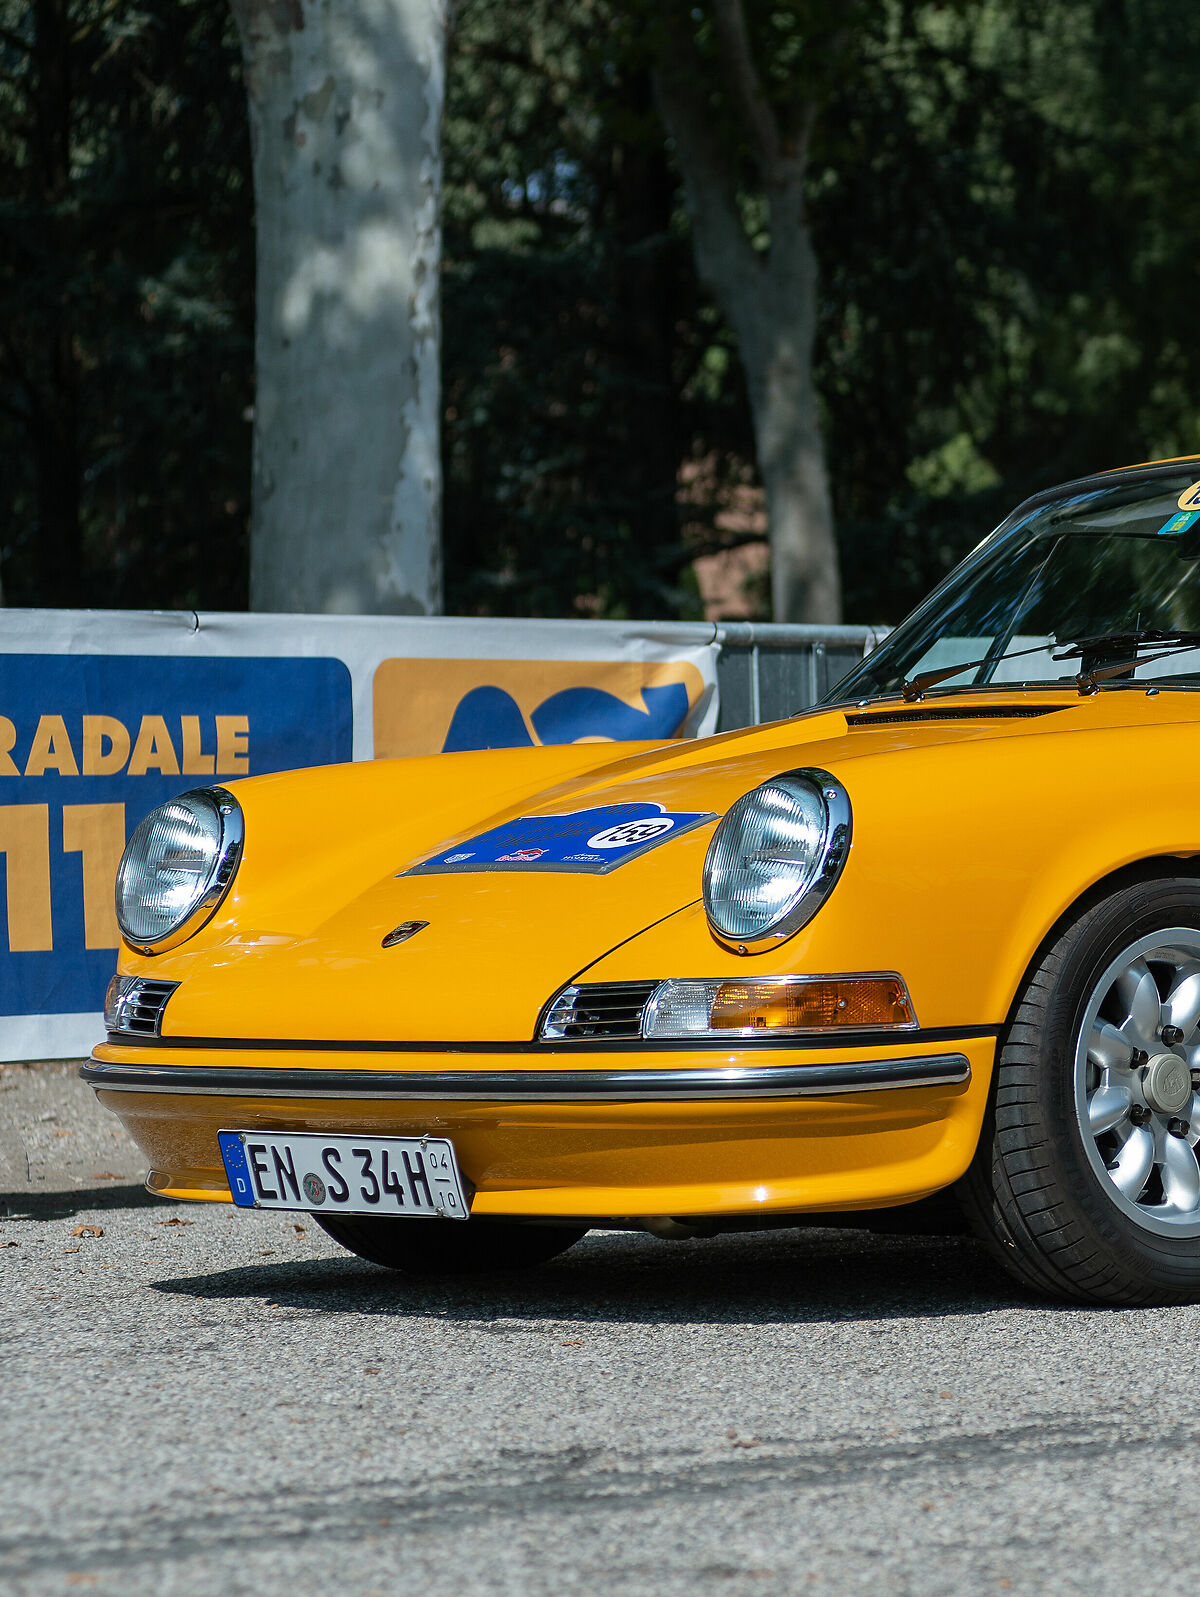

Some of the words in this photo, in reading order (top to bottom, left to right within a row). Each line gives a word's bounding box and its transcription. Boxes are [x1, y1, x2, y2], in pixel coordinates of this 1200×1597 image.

[597, 821, 663, 844] 159
[429, 1152, 448, 1170] 04
[247, 1144, 302, 1202] EN
[236, 1177, 247, 1193] D
[439, 1191, 456, 1208] 10
